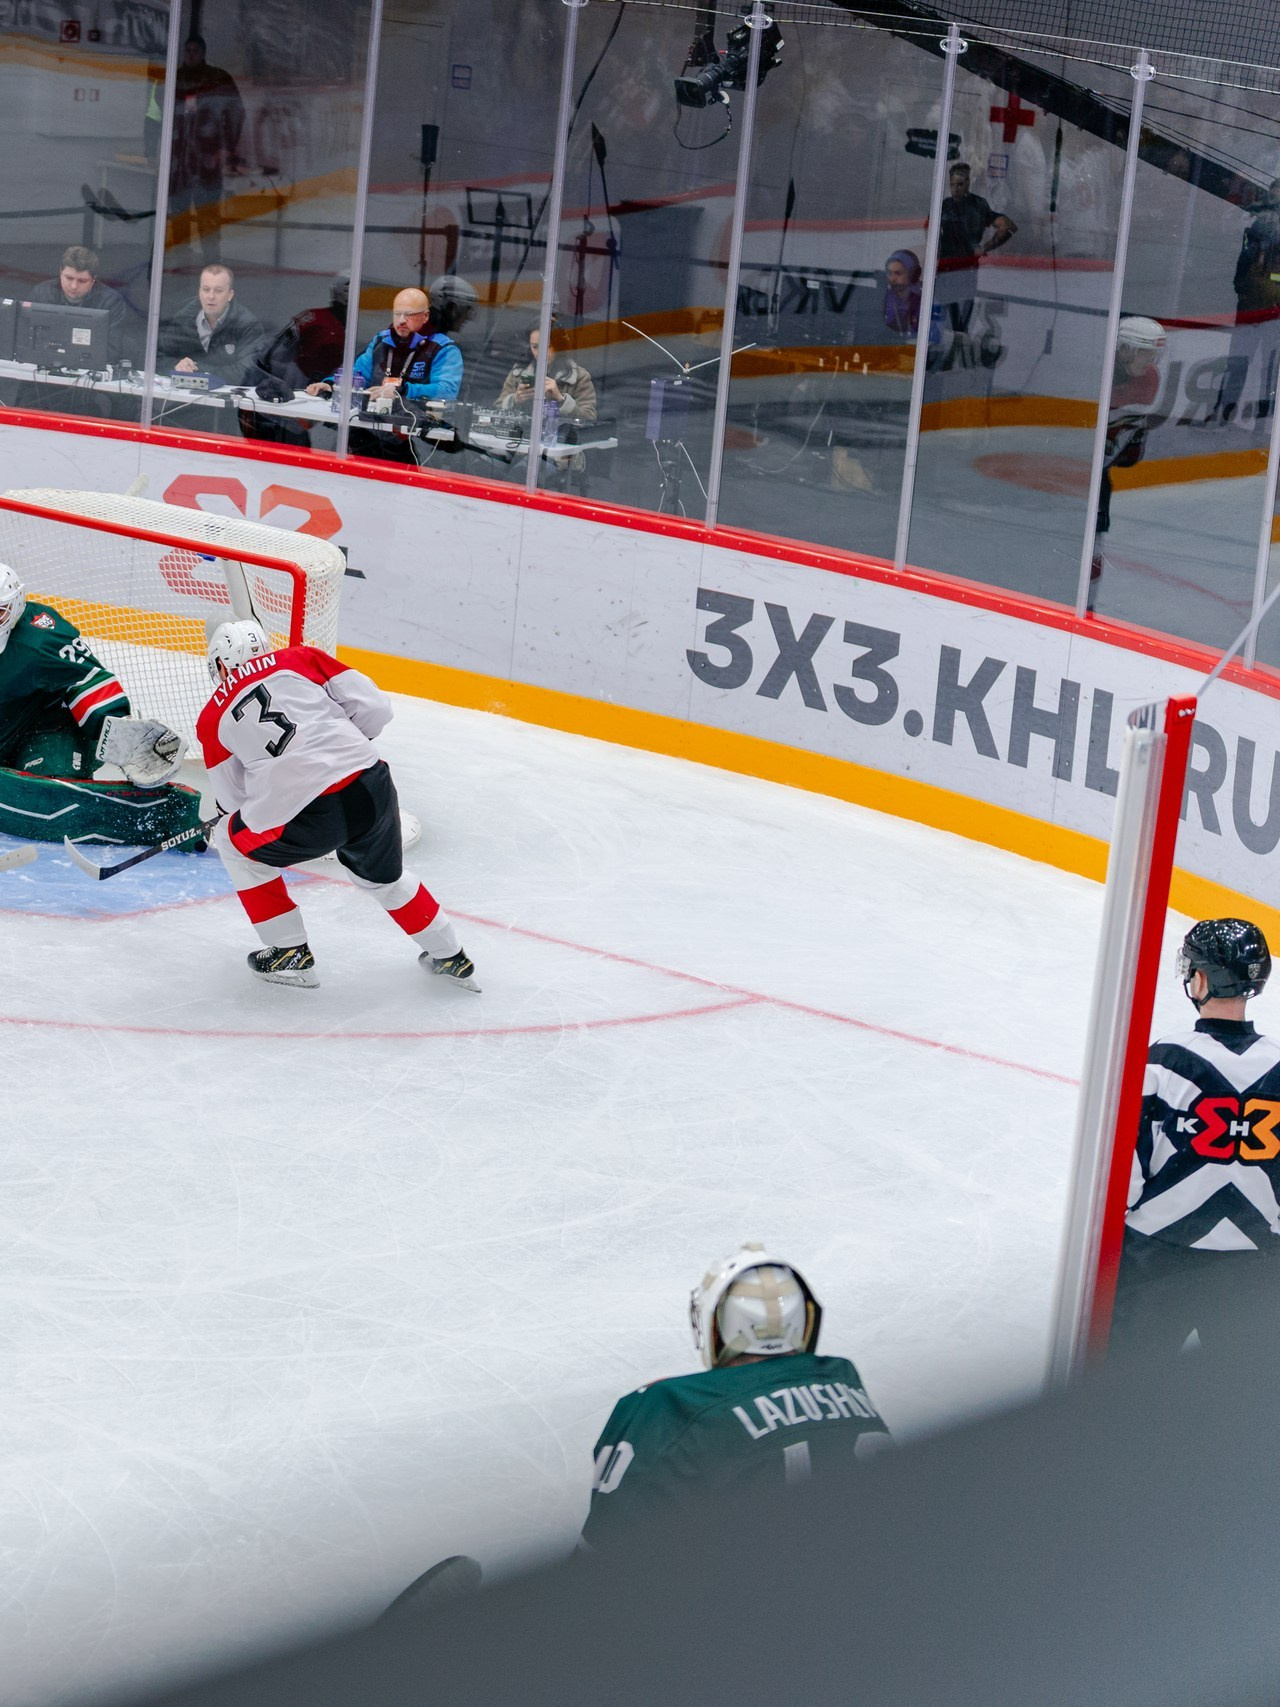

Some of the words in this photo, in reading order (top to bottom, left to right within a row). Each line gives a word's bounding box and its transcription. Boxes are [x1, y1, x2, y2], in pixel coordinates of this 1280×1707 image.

[58, 637, 92, 665] 29
[247, 632, 258, 643] 3
[213, 653, 277, 708] LYAMIN
[231, 682, 298, 758] 3
[161, 827, 196, 852] SOYUZ
